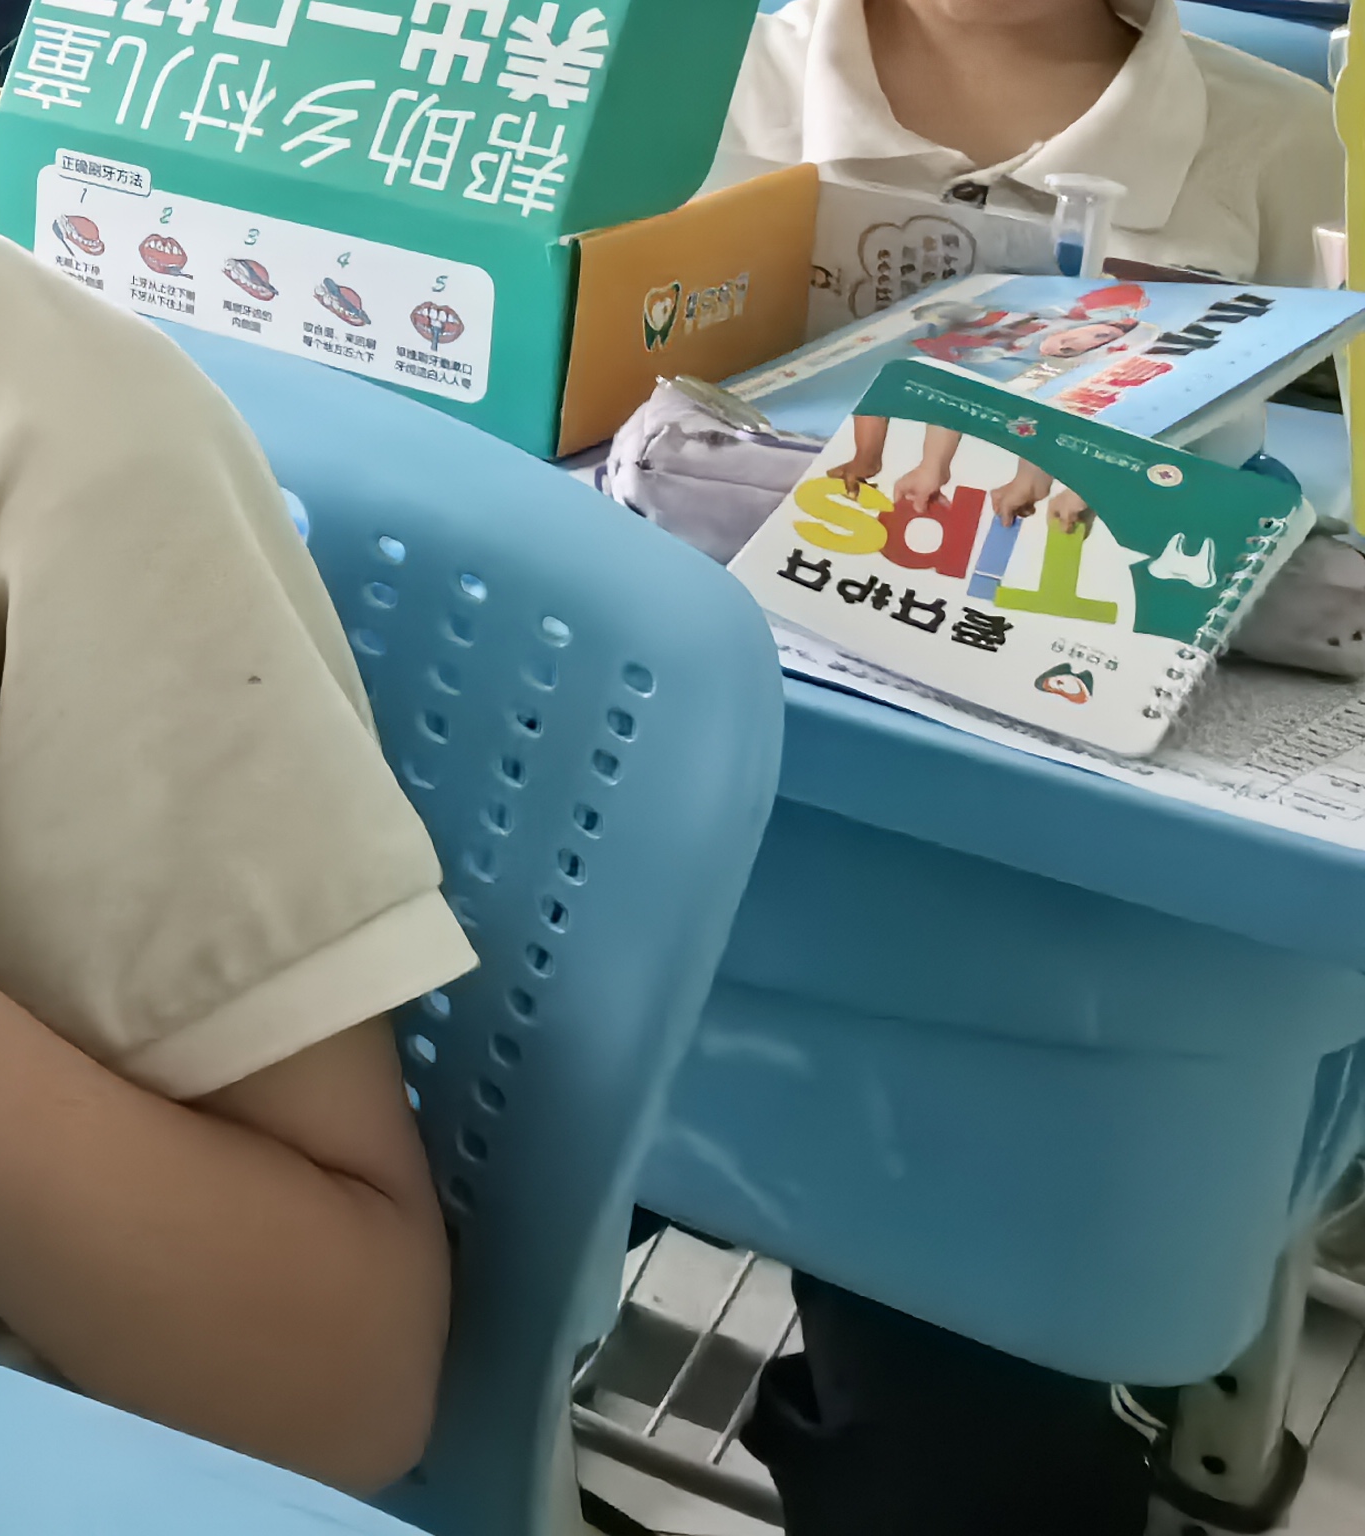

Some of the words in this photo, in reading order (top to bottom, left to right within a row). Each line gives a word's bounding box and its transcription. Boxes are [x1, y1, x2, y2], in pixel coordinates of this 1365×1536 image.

[13, 16, 569, 218] 帮助乡村儿童
[159, 207, 173, 224] 2
[244, 228, 260, 246] 3
[336, 251, 351, 268] 4
[432, 275, 448, 293] 5
[792, 477, 1118, 625] Tips
[777, 547, 1014, 653] 爱牙护牙
